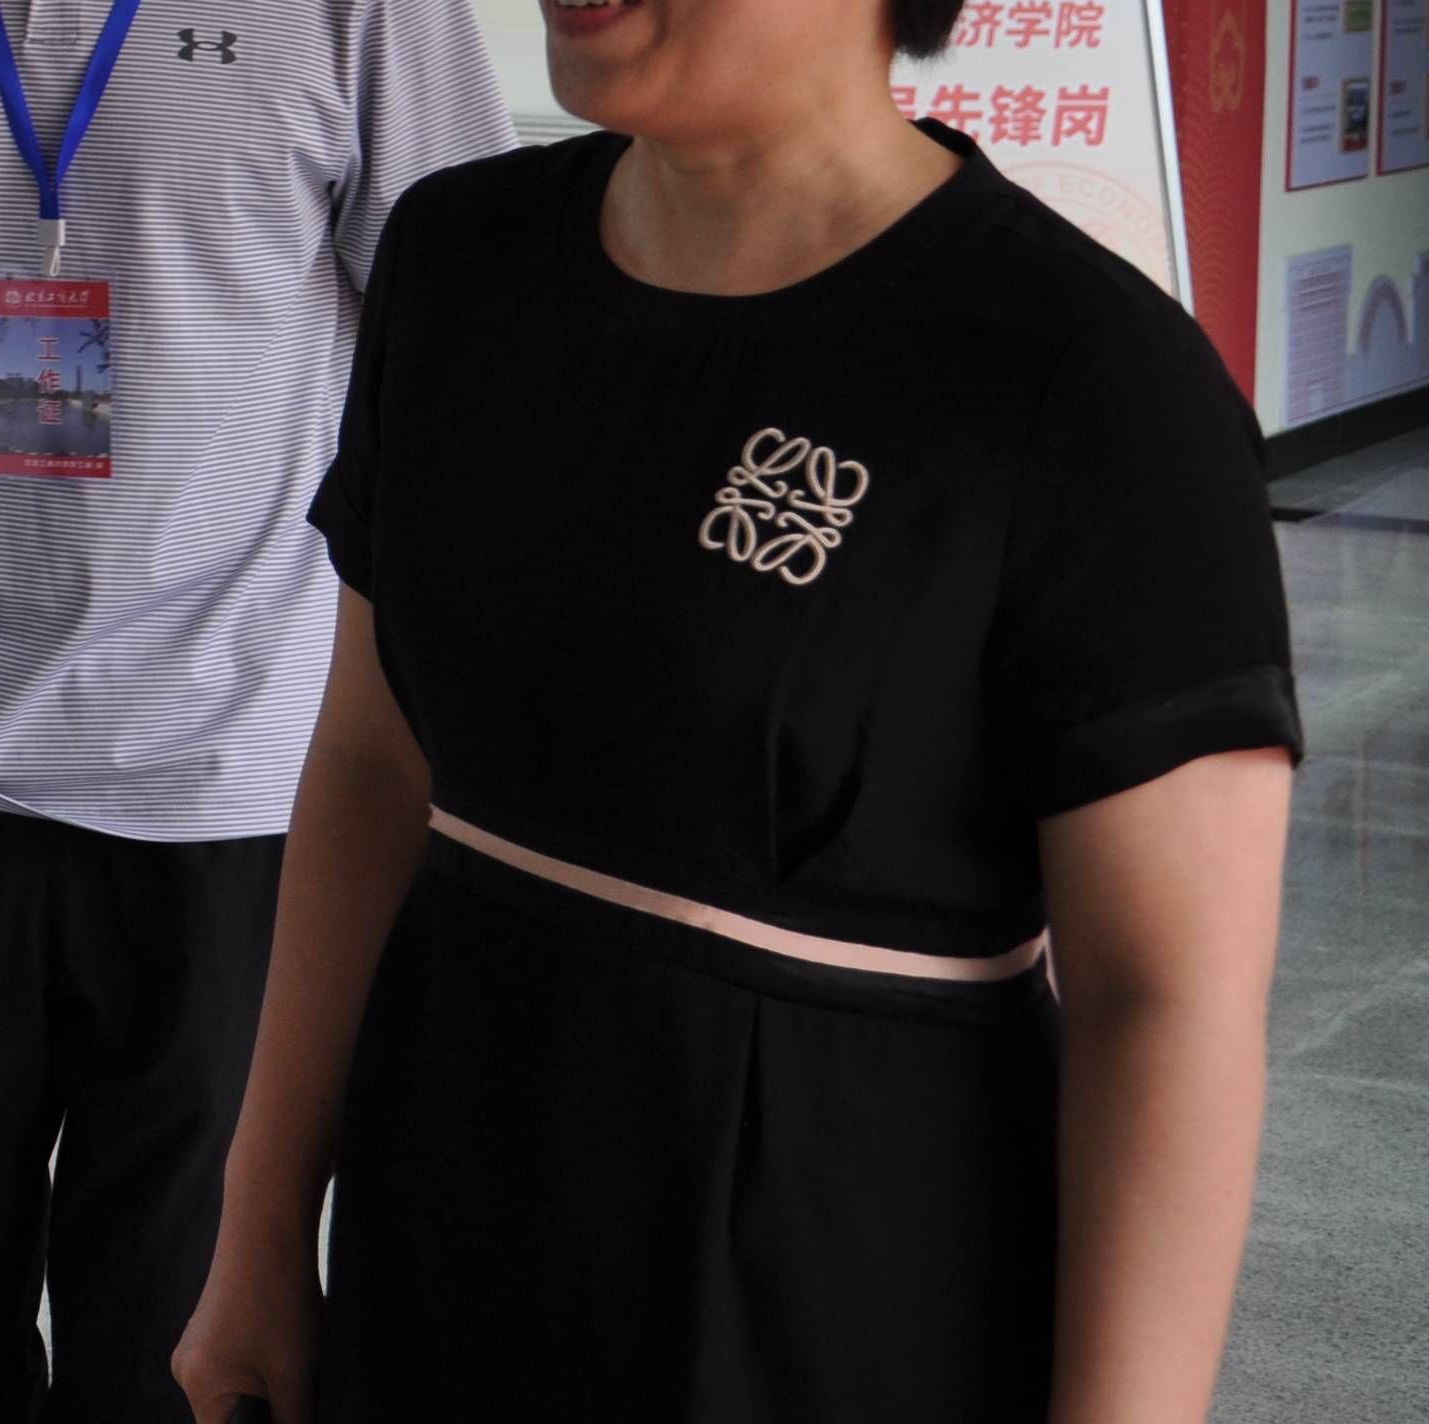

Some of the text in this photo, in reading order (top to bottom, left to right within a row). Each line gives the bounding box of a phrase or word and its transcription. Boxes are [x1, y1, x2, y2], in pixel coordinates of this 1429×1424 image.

[956, 0, 1105, 48] 济学院
[37, 336, 62, 424] 工作证
